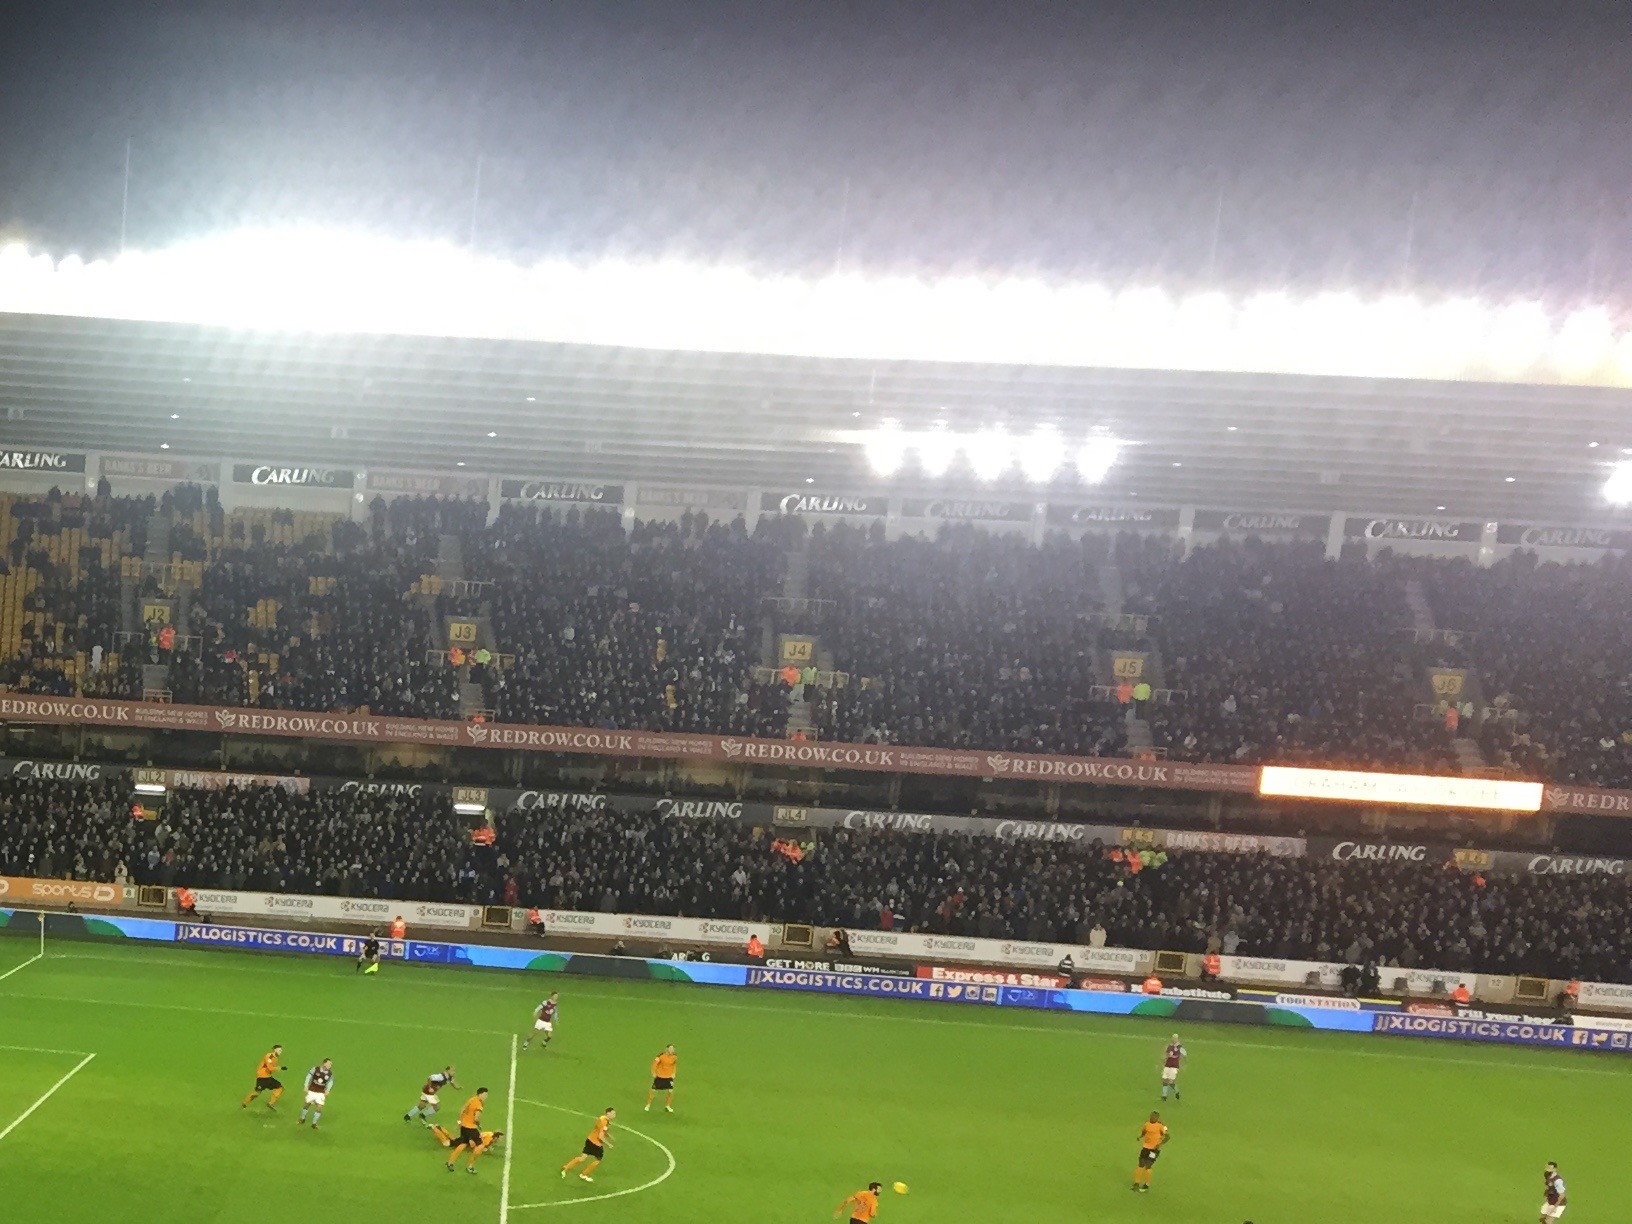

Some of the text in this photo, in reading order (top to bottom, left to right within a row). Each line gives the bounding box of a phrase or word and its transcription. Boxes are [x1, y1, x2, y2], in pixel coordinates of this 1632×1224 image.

[251, 466, 335, 485] CARLING
[519, 481, 605, 501] CARLING
[779, 494, 867, 515] CARLING
[1365, 519, 1458, 539] CARLING
[149, 608, 164, 621] J2
[455, 625, 472, 640] J3
[788, 644, 806, 657] J4
[1118, 661, 1137, 674] J5
[238, 713, 381, 736] REDROW.CO.UK
[489, 728, 632, 751] REDROW.CO.UK
[745, 743, 895, 767] REDROW.CO.UK
[13, 760, 101, 781] CARLING
[1012, 756, 1168, 782] REDROW.CO.UK
[517, 791, 607, 811] CARLING
[655, 798, 743, 820] CARLING
[995, 820, 1086, 842] CARLING
[1332, 841, 1427, 862] CARLING
[1527, 855, 1625, 876] CARLING
[177, 926, 337, 950] JJXLOGISTICS.CO.UK
[766, 959, 793, 970] GET
[795, 960, 830, 973] MORE
[750, 968, 923, 995] JJXLOGISTICS.CO.UK
[1376, 1013, 1567, 1041] JJXLOGISTICS.CO.UK
